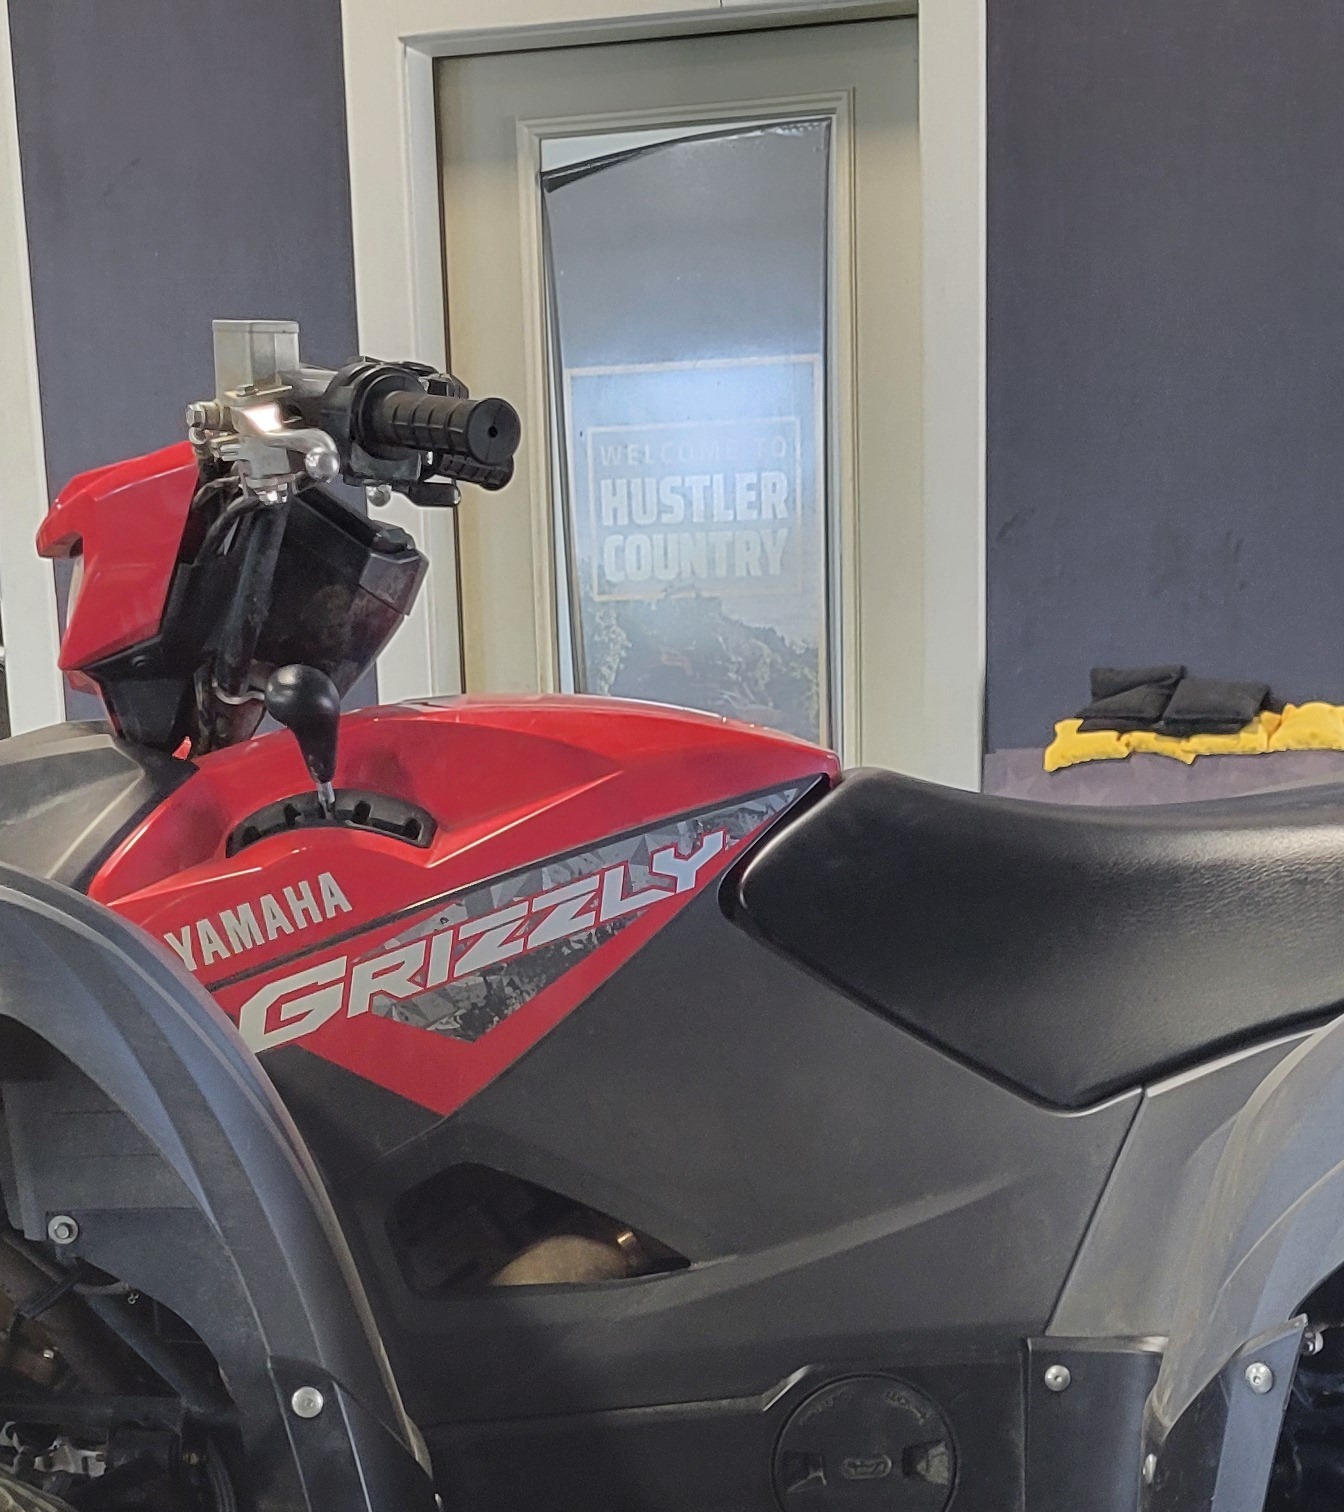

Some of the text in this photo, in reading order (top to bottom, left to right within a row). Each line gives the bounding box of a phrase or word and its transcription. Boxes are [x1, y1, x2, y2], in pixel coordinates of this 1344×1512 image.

[599, 438, 739, 467] WELCOME
[599, 471, 789, 527] HUSTLER
[602, 528, 789, 582] COUNTRY
[163, 871, 353, 973] YAMAHA
[236, 829, 728, 1056] GRIZZLY
